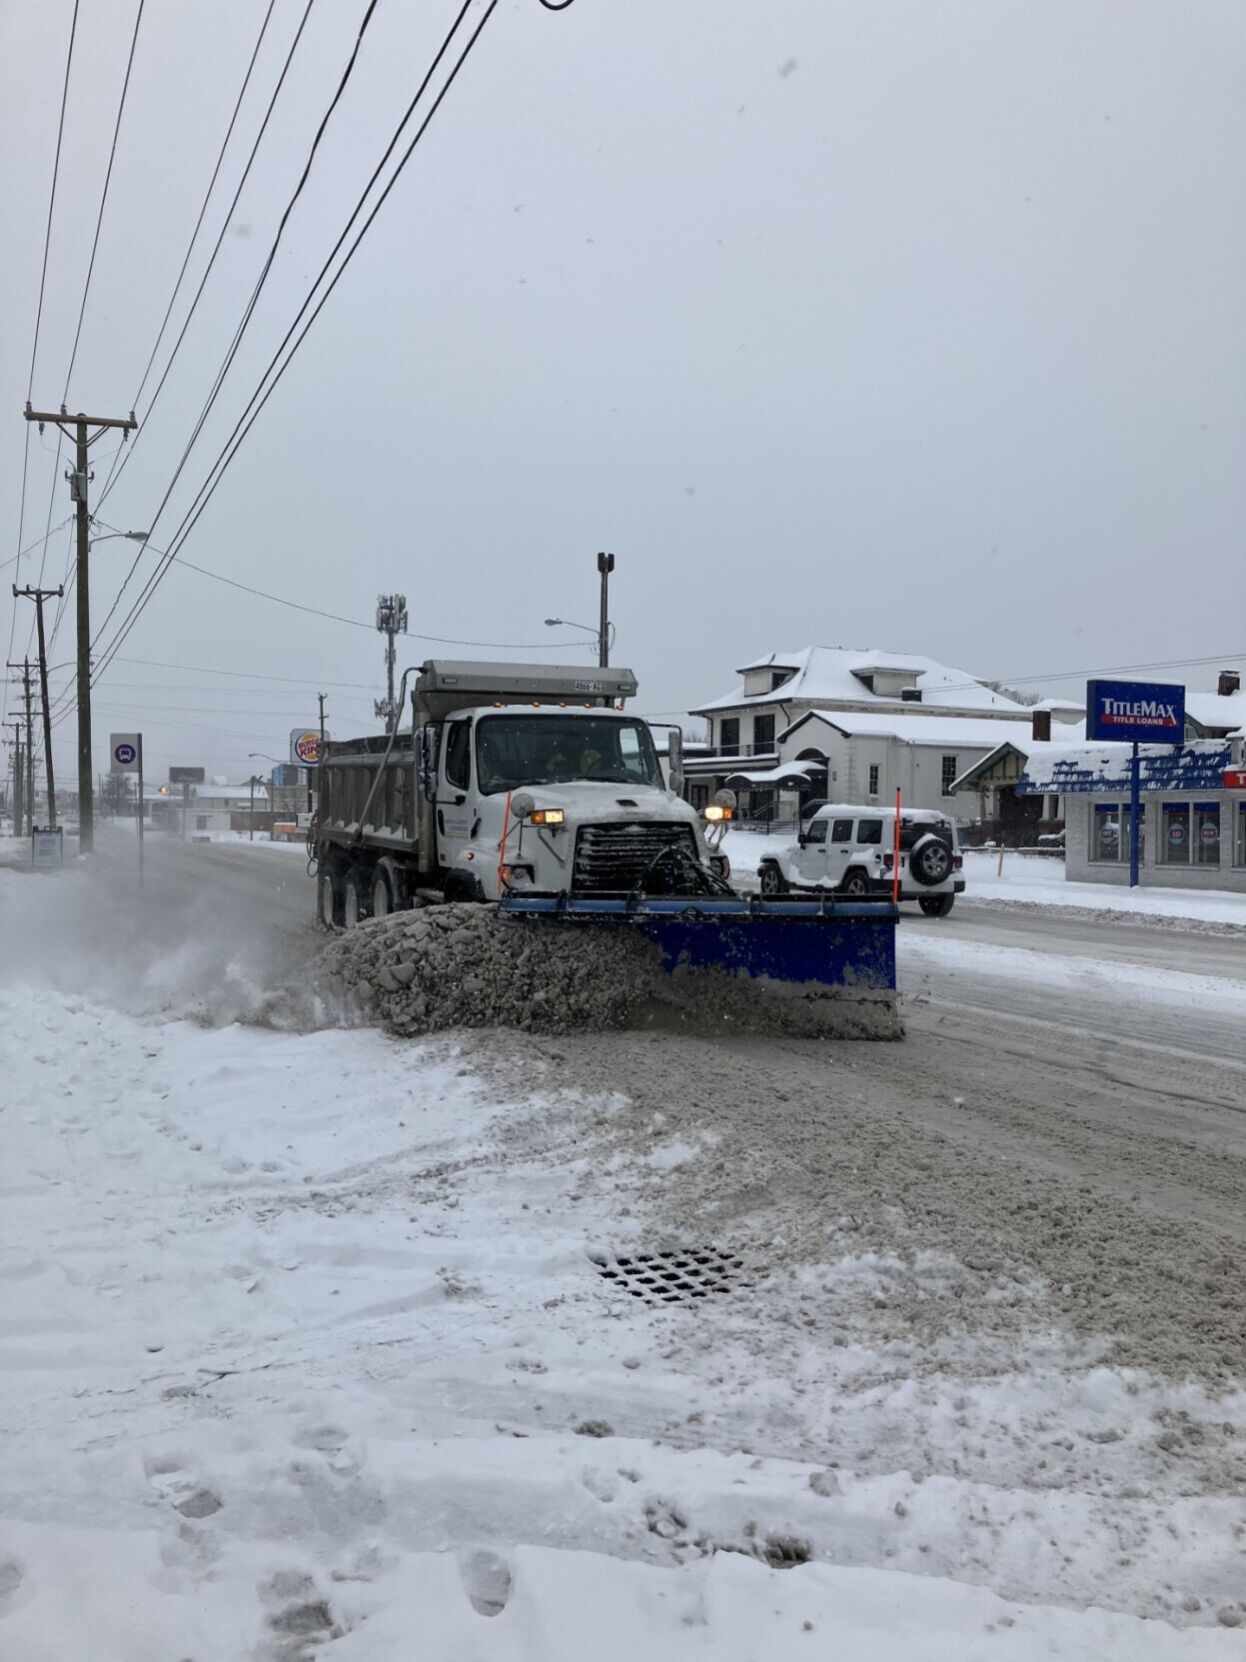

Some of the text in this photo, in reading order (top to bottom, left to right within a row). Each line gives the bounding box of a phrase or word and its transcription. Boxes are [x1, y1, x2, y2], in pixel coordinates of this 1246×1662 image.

[1113, 716, 1164, 725] TITLE LOANS
[300, 745, 318, 756] KIN
